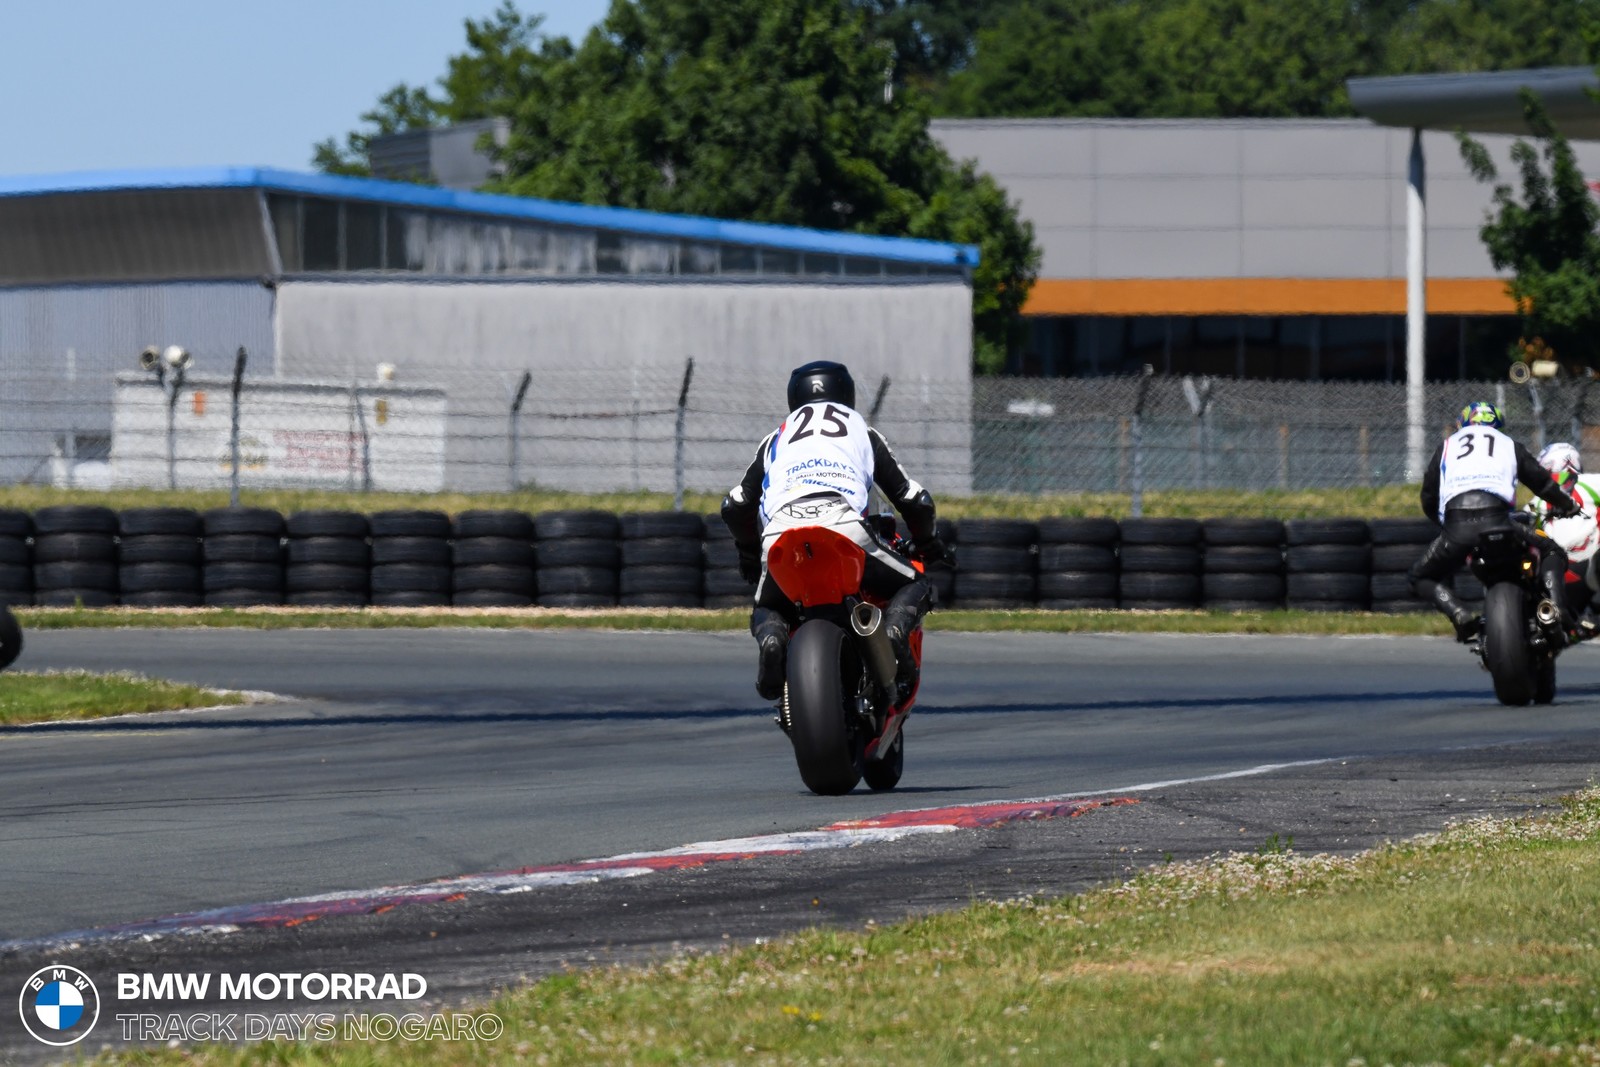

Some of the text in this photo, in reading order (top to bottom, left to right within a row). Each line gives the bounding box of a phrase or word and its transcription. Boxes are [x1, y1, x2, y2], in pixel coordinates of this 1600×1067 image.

[788, 404, 850, 445] 25
[1456, 433, 1496, 460] 31
[786, 458, 856, 476] TRACKDAYS
